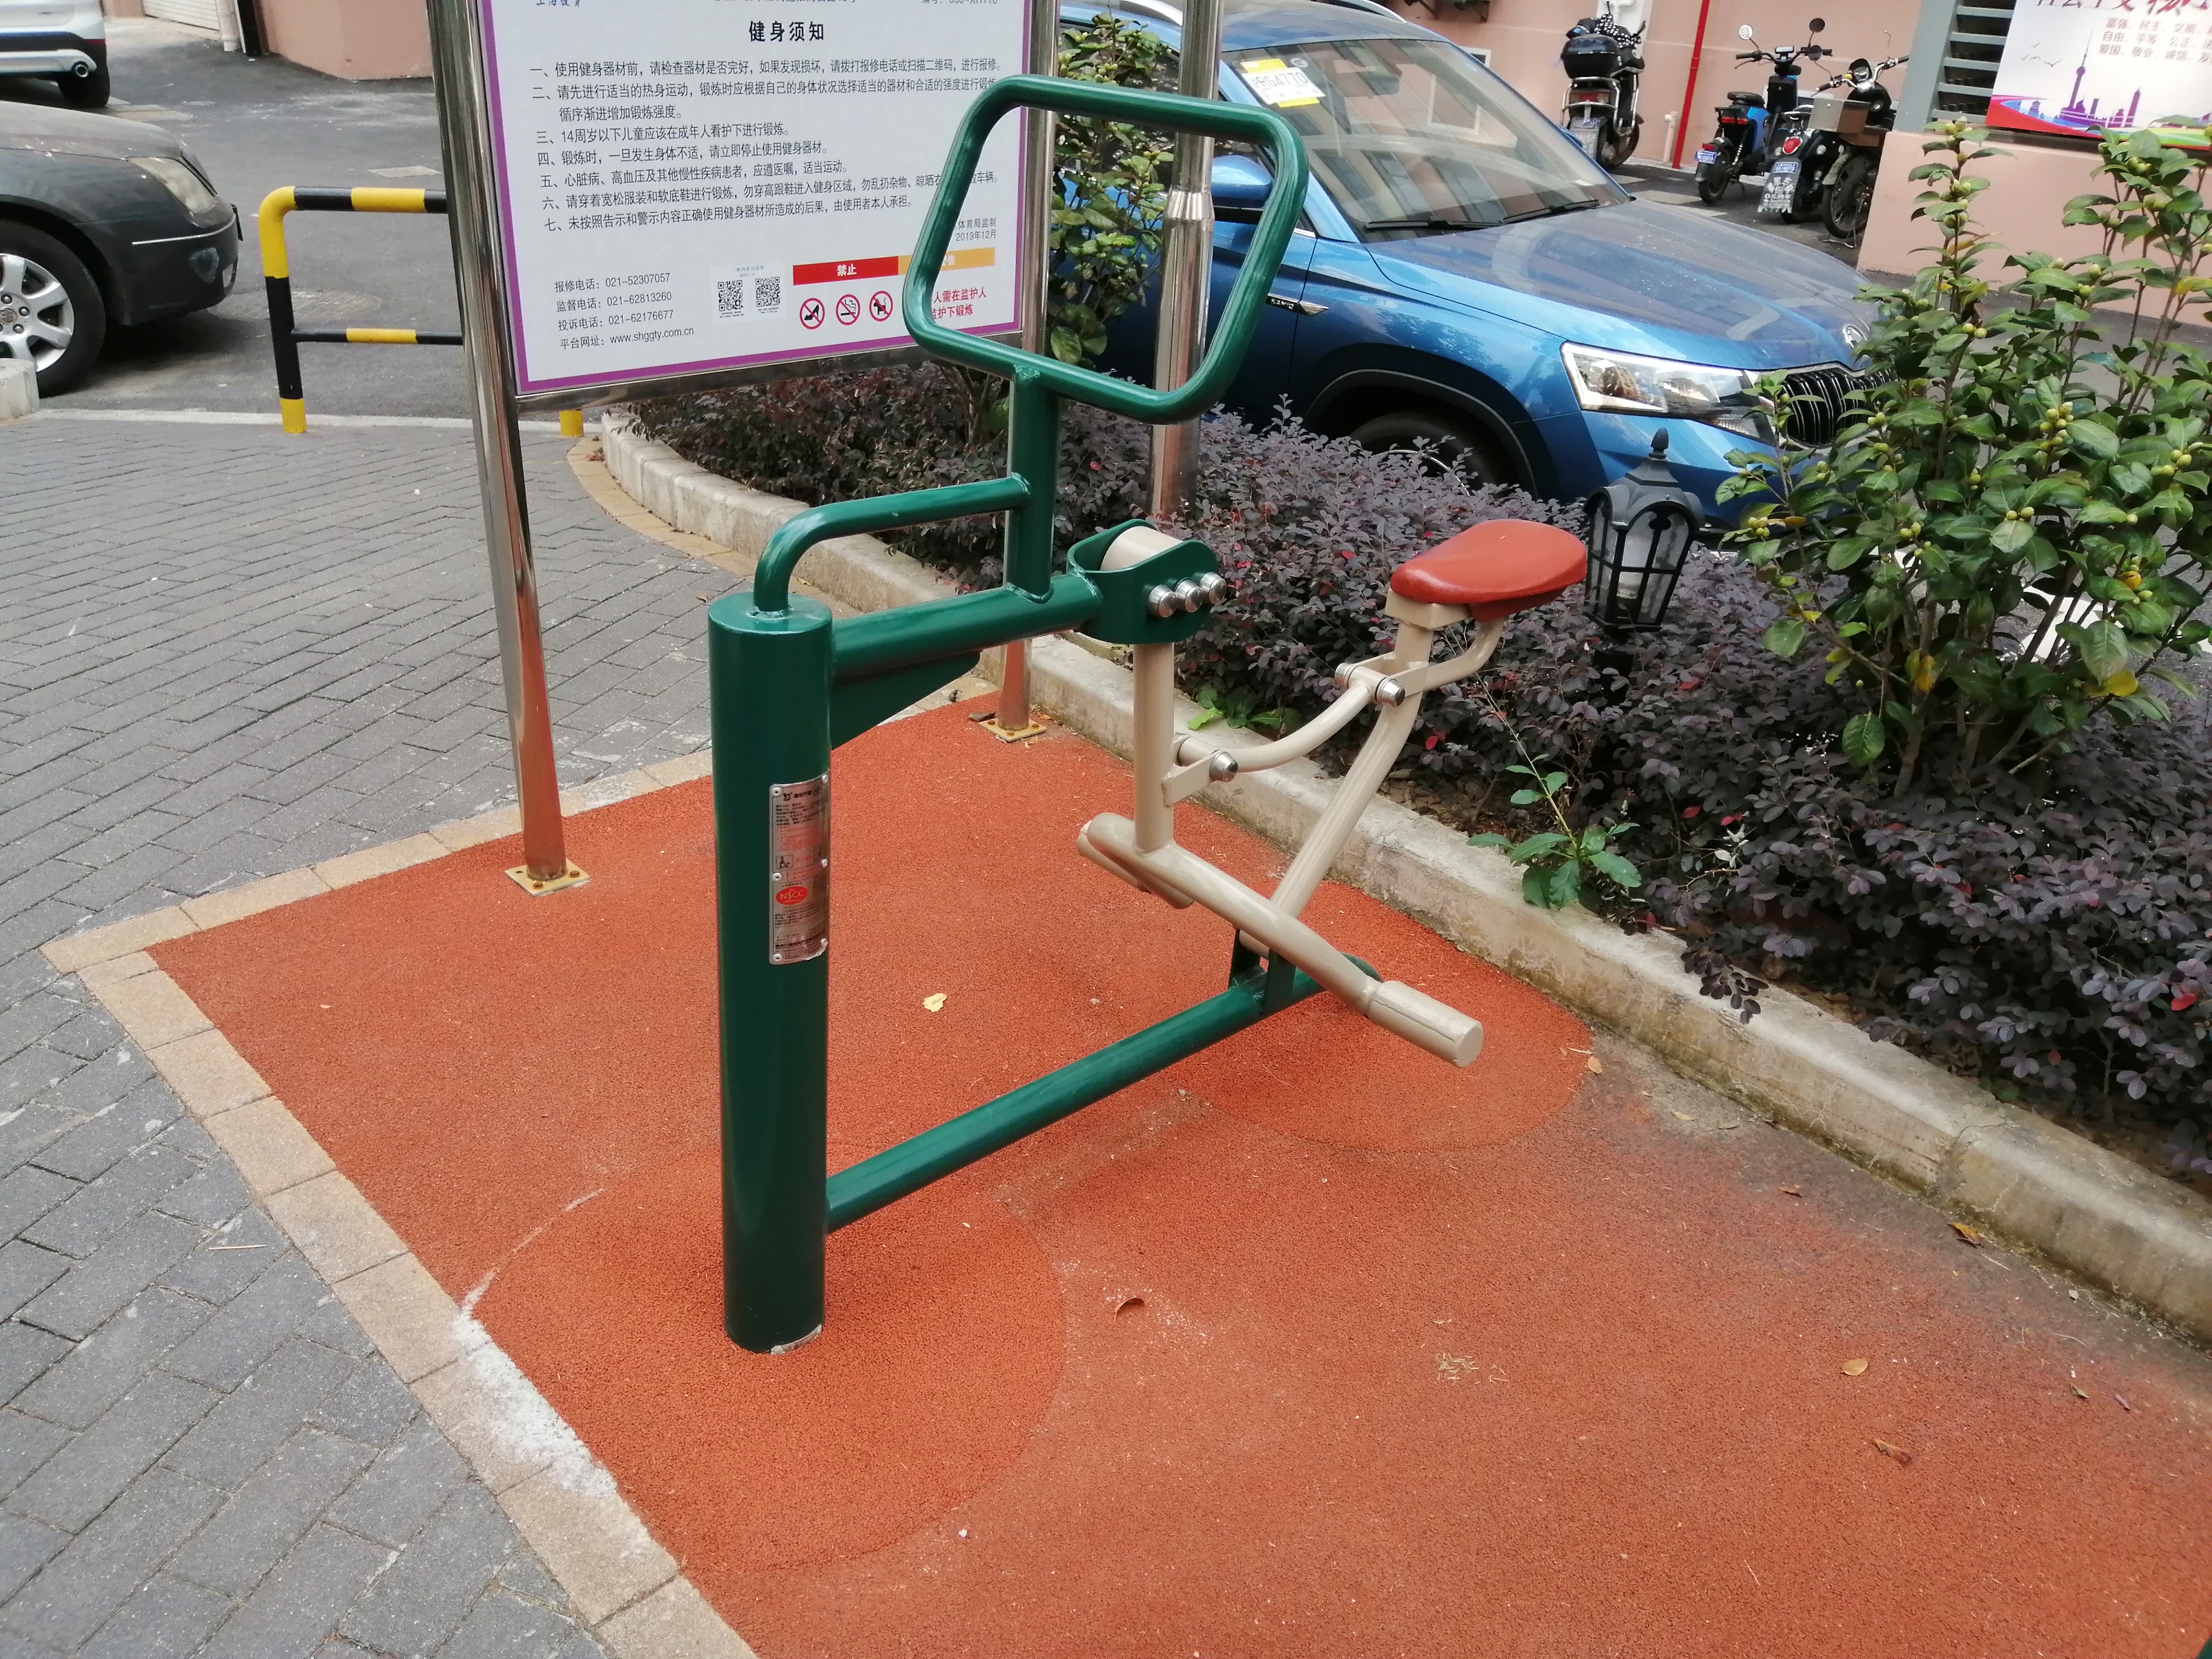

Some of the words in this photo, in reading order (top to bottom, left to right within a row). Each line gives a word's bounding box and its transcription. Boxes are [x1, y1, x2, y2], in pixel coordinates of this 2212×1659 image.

[749, 21, 824, 42] 健身须知
[559, 105, 682, 122] 循序渐进增加锻炼强度。
[536, 122, 789, 144] 三、14周岁以下儿童应该在成年人看护下进行锻炼。
[537, 140, 827, 166] 四、锻炼时，一旦发生身体不适，请立即停止使用健身器材。
[541, 161, 847, 188] 五、心脏病、高血压及其他慢性疾病患者，应遵医嘱，适当运动。
[544, 196, 912, 231] 七、未按照告示和警示内容正确使用健身器材所造成的后果，由使用者本人承担。
[954, 217, 997, 230] 体育局监制
[956, 229, 996, 241] 2019年12月
[837, 264, 857, 277] 禁止
[932, 287, 987, 304] 人需在监护人
[1271, 298, 1294, 311] KAMIQ
